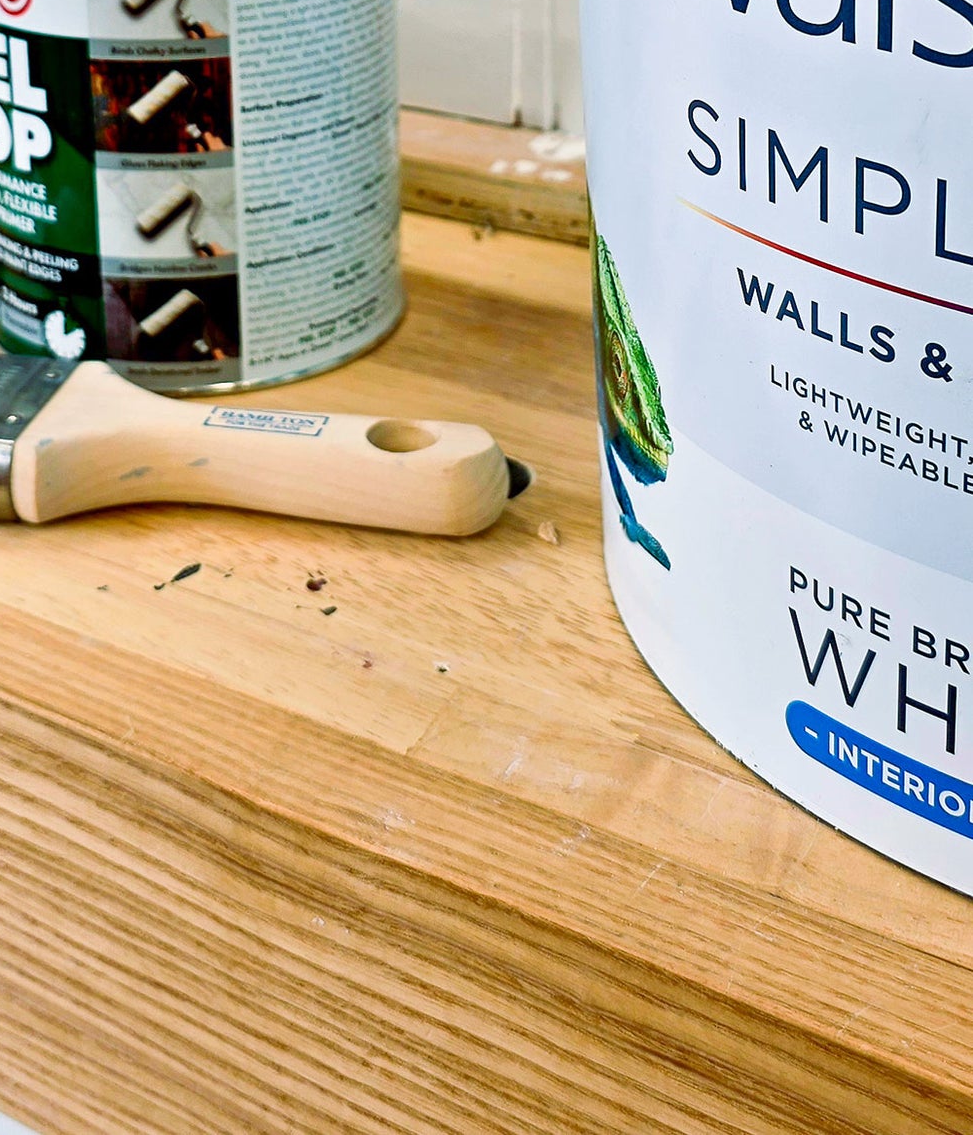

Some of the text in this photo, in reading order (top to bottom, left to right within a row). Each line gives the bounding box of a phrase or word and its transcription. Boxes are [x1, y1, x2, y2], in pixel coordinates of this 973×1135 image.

[687, 99, 973, 265] SIMPL
[736, 267, 953, 383] WALLS &
[770, 363, 973, 465] LIGHTWEIGHT,
[798, 410, 973, 495] & WIPEABLE
[789, 565, 970, 675] PURE BR
[788, 606, 957, 755] WH
